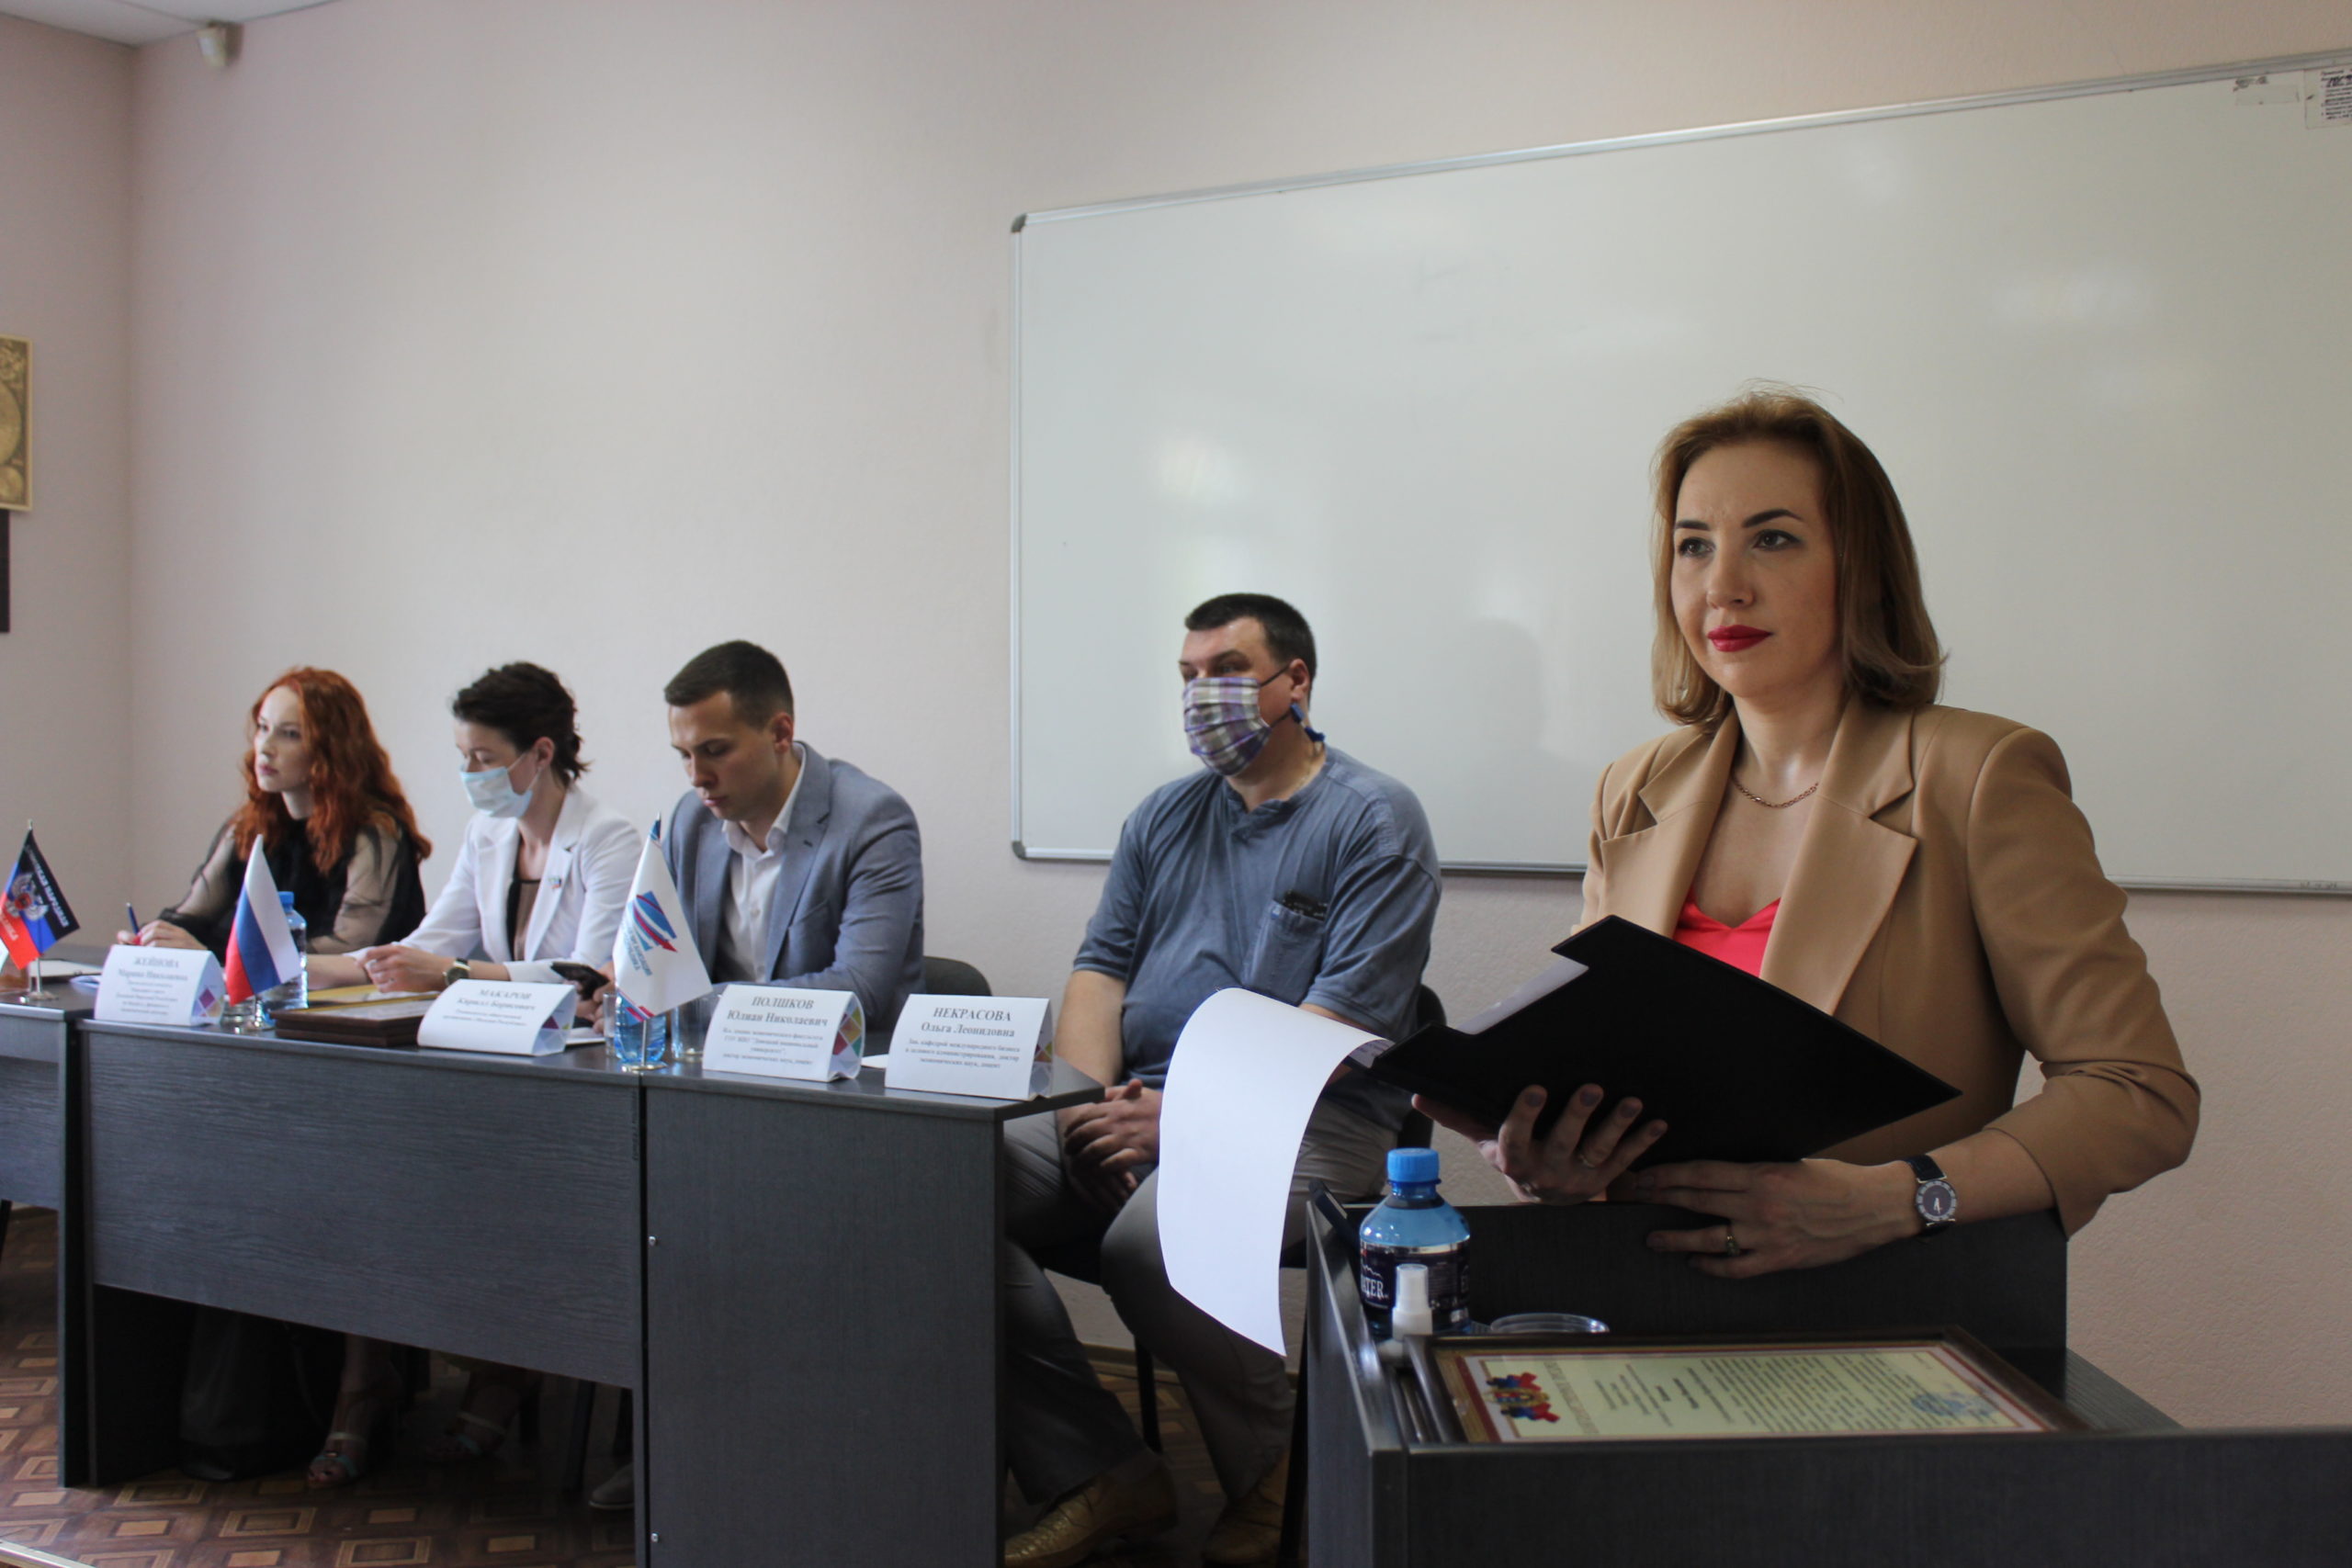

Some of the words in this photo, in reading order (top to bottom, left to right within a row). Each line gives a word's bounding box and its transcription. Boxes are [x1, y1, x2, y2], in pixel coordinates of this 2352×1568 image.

[752, 996, 814, 1010] ПОЛШКОВ
[728, 1010, 763, 1022] Юлиан
[765, 1011, 829, 1027] Николаевич
[933, 1007, 1012, 1021] НЕКРАСОВА
[922, 1021, 952, 1033] Ольга
[954, 1023, 1015, 1037] Леонидовна
[1361, 1274, 1384, 1300] ATER
